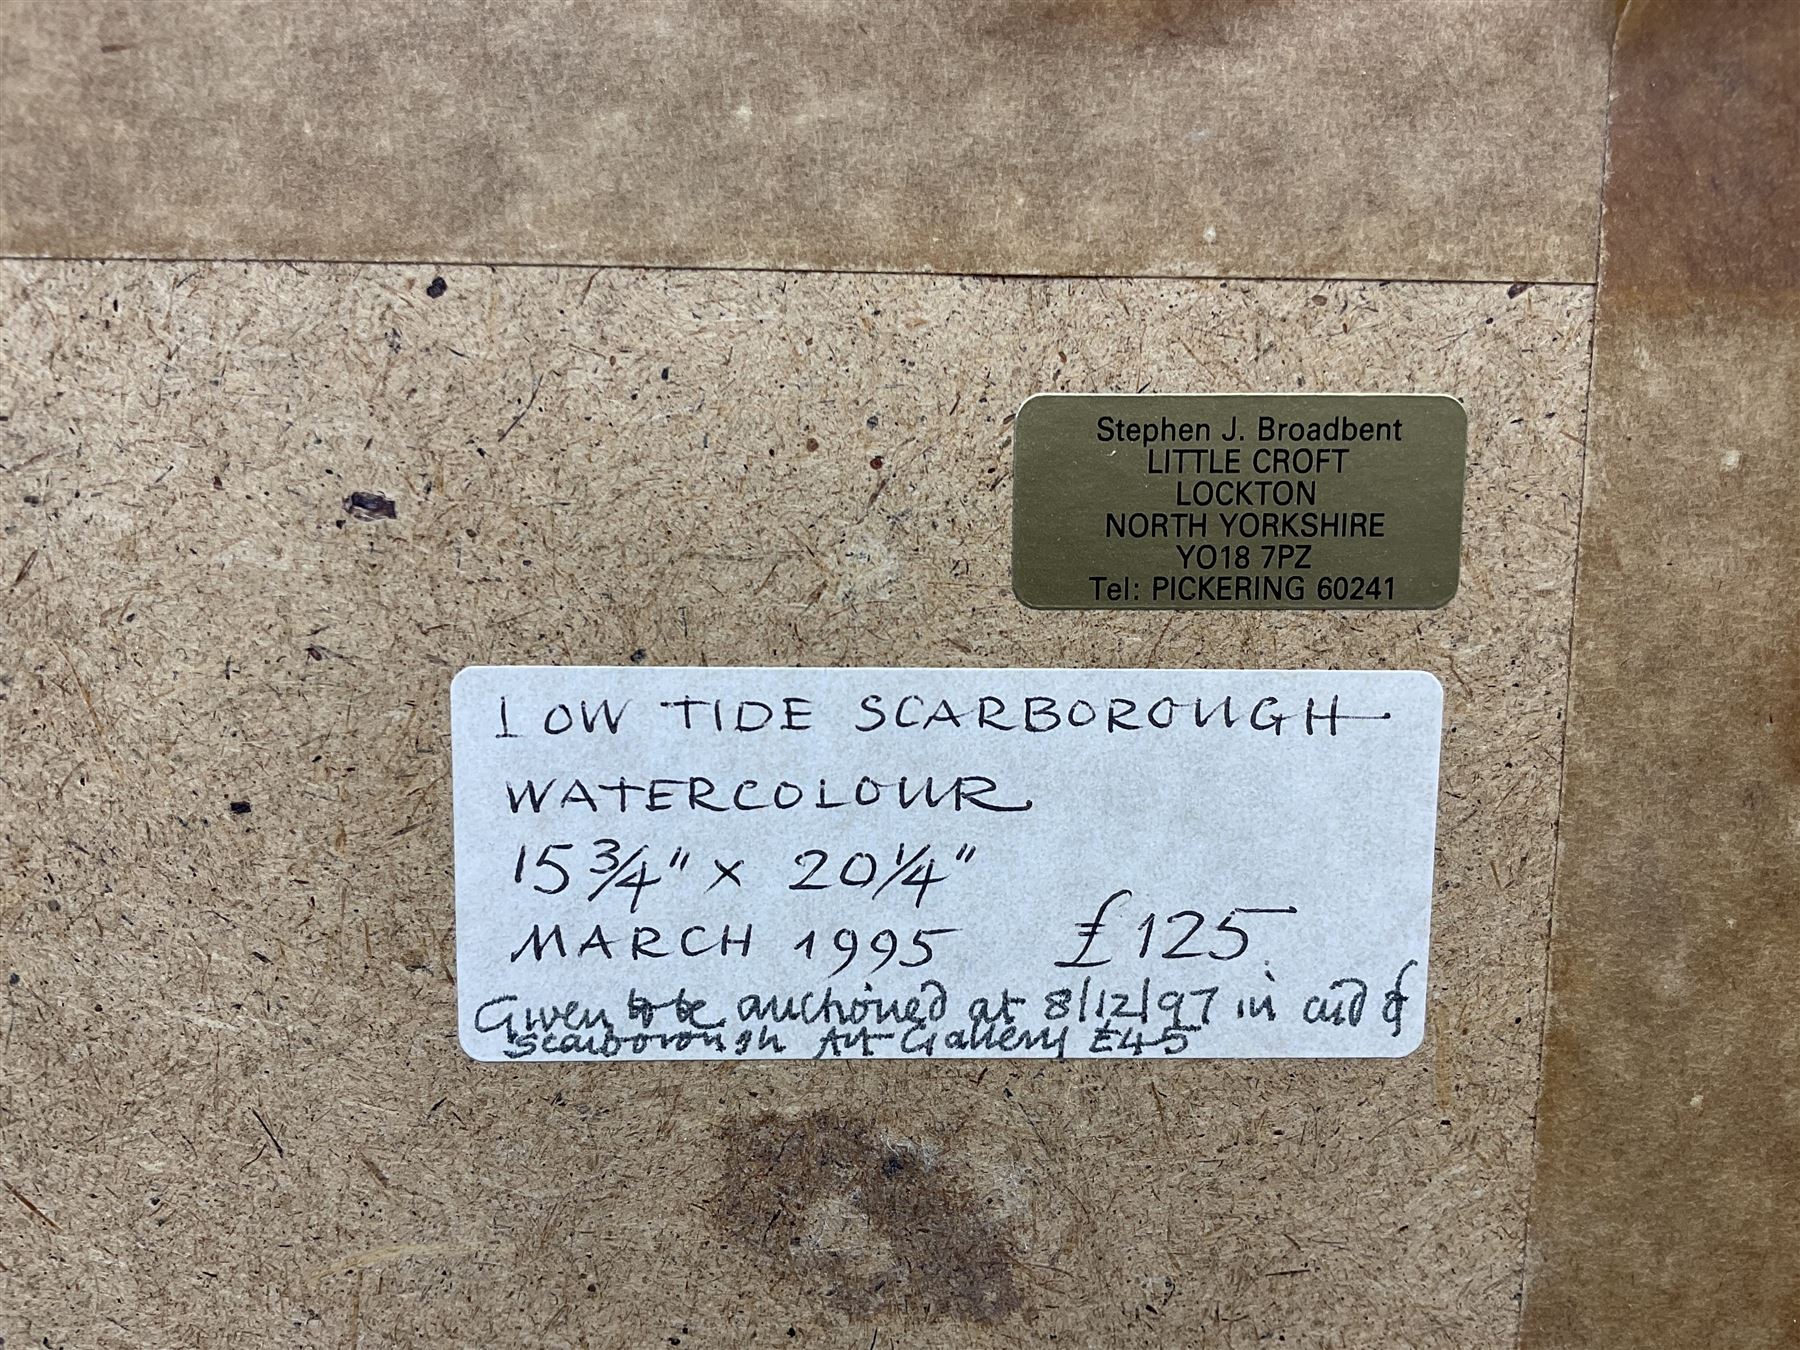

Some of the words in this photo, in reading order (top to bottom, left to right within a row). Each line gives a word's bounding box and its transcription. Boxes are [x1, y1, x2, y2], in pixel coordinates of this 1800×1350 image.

[1097, 416, 1210, 446] Stephen
[1222, 417, 1245, 441] J.
[1258, 416, 1403, 442] Broadbent
[1148, 449, 1240, 473] LITTLE
[1252, 449, 1349, 474] CROFT
[1176, 481, 1316, 506] LOCKTON
[1106, 513, 1207, 538] NORTH
[1220, 513, 1385, 537] YORKSHIRE
[1176, 545, 1250, 569] YO18
[1260, 545, 1312, 569] 7PZ
[1089, 577, 1140, 600] Tel:
[1152, 577, 1305, 601] PICKERING
[1317, 577, 1395, 600] 60241
[496, 696, 634, 738] LOW
[660, 695, 813, 733] TIDE
[855, 694, 1391, 736] SCARBOROUGH
[506, 776, 1033, 813] WATERCOLOUR
[510, 923, 754, 963] MARCH
[793, 927, 963, 979] 1995
[474, 995, 614, 1043] Given
[736, 979, 947, 1025] auctioned
[968, 988, 1026, 1025] at
[1044, 976, 1219, 1033] 8/12/97
[1236, 969, 1277, 1021] in
[1302, 977, 1367, 1027] aid
[1381, 959, 1418, 1037] of
[813, 1025, 895, 1059] Art
[900, 1023, 1070, 1062] Gallery
